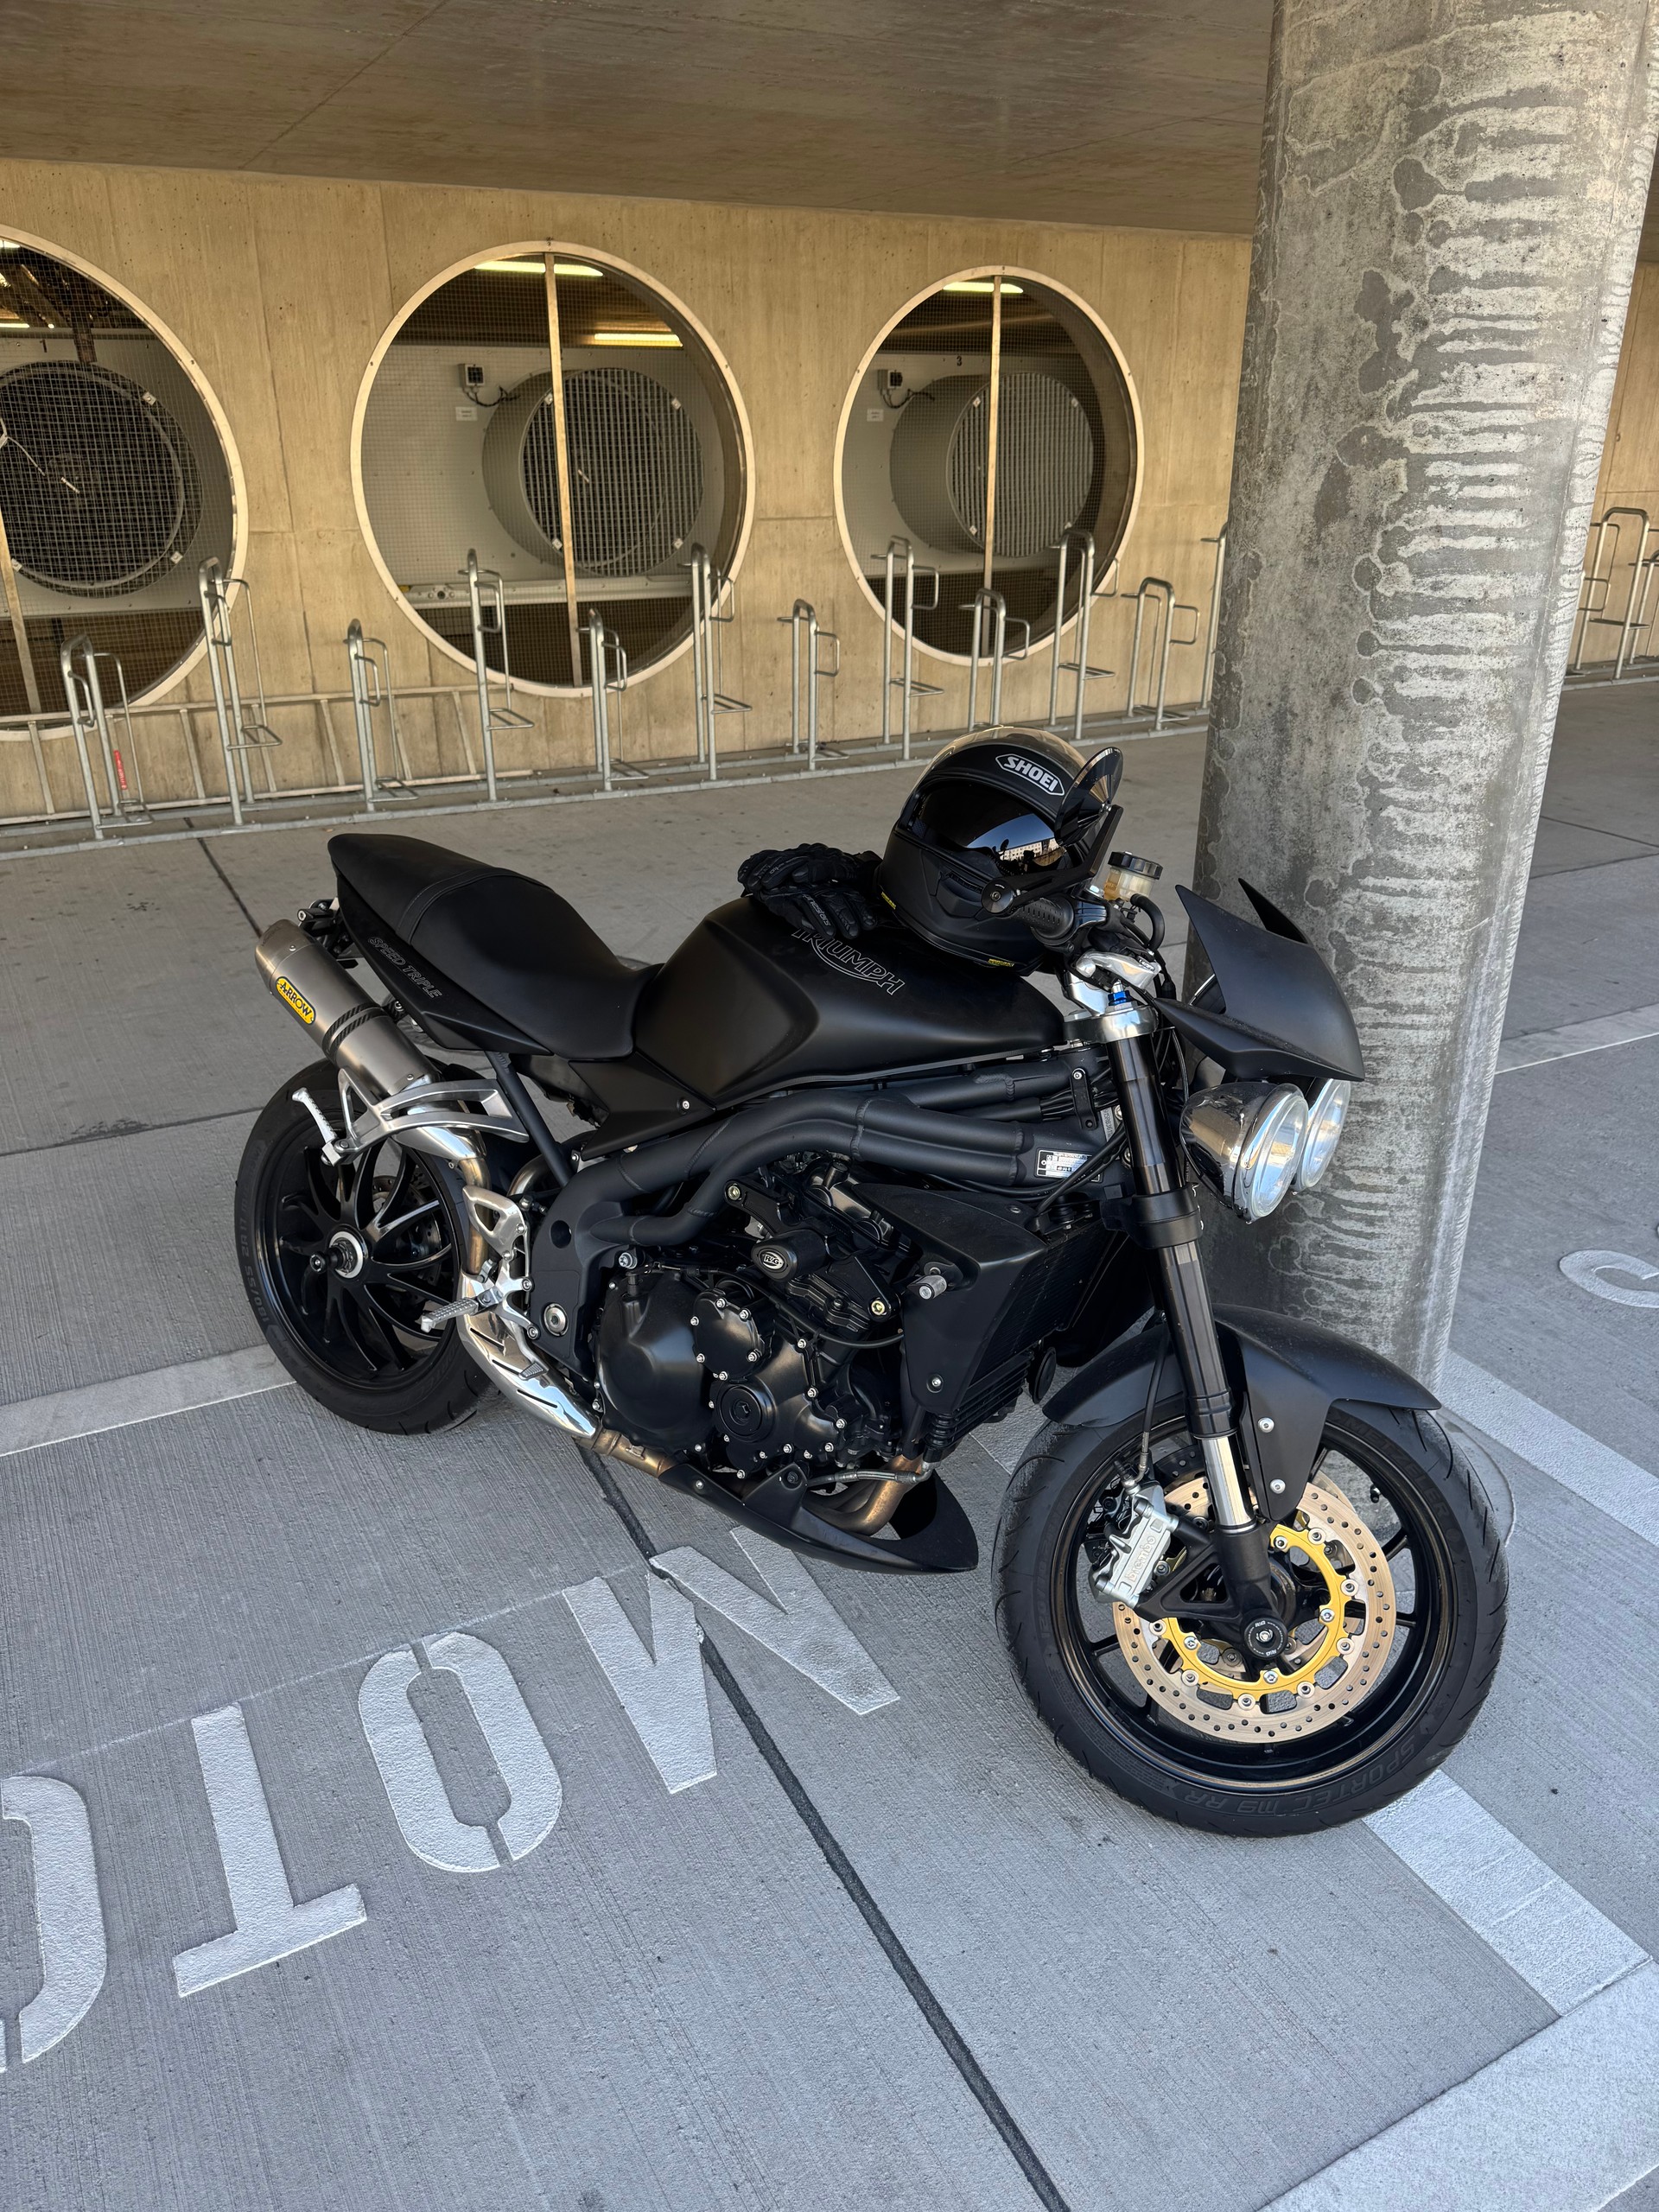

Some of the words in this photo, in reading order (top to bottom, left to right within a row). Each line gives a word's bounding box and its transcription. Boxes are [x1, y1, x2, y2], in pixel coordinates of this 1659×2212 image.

[1003, 755, 1058, 792] SHOEI
[367, 936, 406, 966] SPEED
[402, 964, 442, 999] TRIPLE
[279, 981, 313, 1017] ARROW
[245, 1265, 270, 1324] 180/55
[1344, 1419, 1451, 1516] METZELER
[1123, 1534, 1157, 1582] brembo
[1293, 1733, 1417, 1811] SPORTEC
[1183, 1790, 1229, 1811] RR
